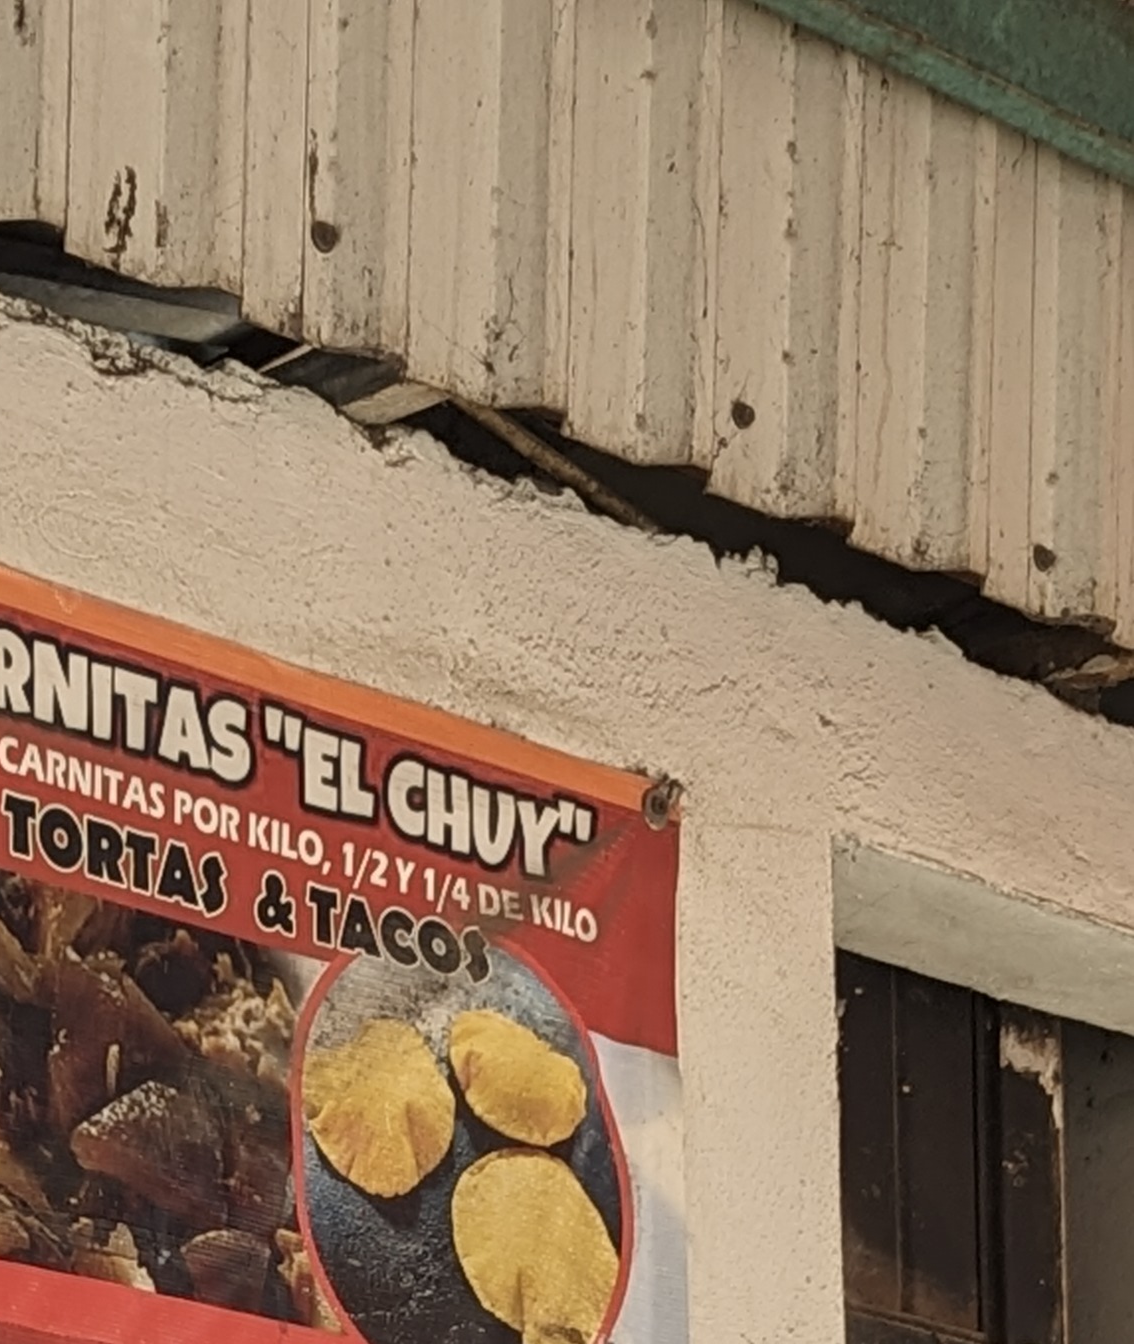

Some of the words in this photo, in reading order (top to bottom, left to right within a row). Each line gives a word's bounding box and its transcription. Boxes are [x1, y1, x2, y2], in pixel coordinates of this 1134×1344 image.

[2, 791, 228, 917] TORTAS
[254, 872, 296, 935] &
[306, 886, 492, 984] TACOS
[174, 787, 241, 840] POR
[248, 813, 334, 876] KILO,
[341, 843, 387, 893] 1/2
[394, 860, 416, 892] Y
[424, 866, 470, 913] 1/4
[478, 882, 526, 921] DE
[531, 897, 598, 943] KILO
